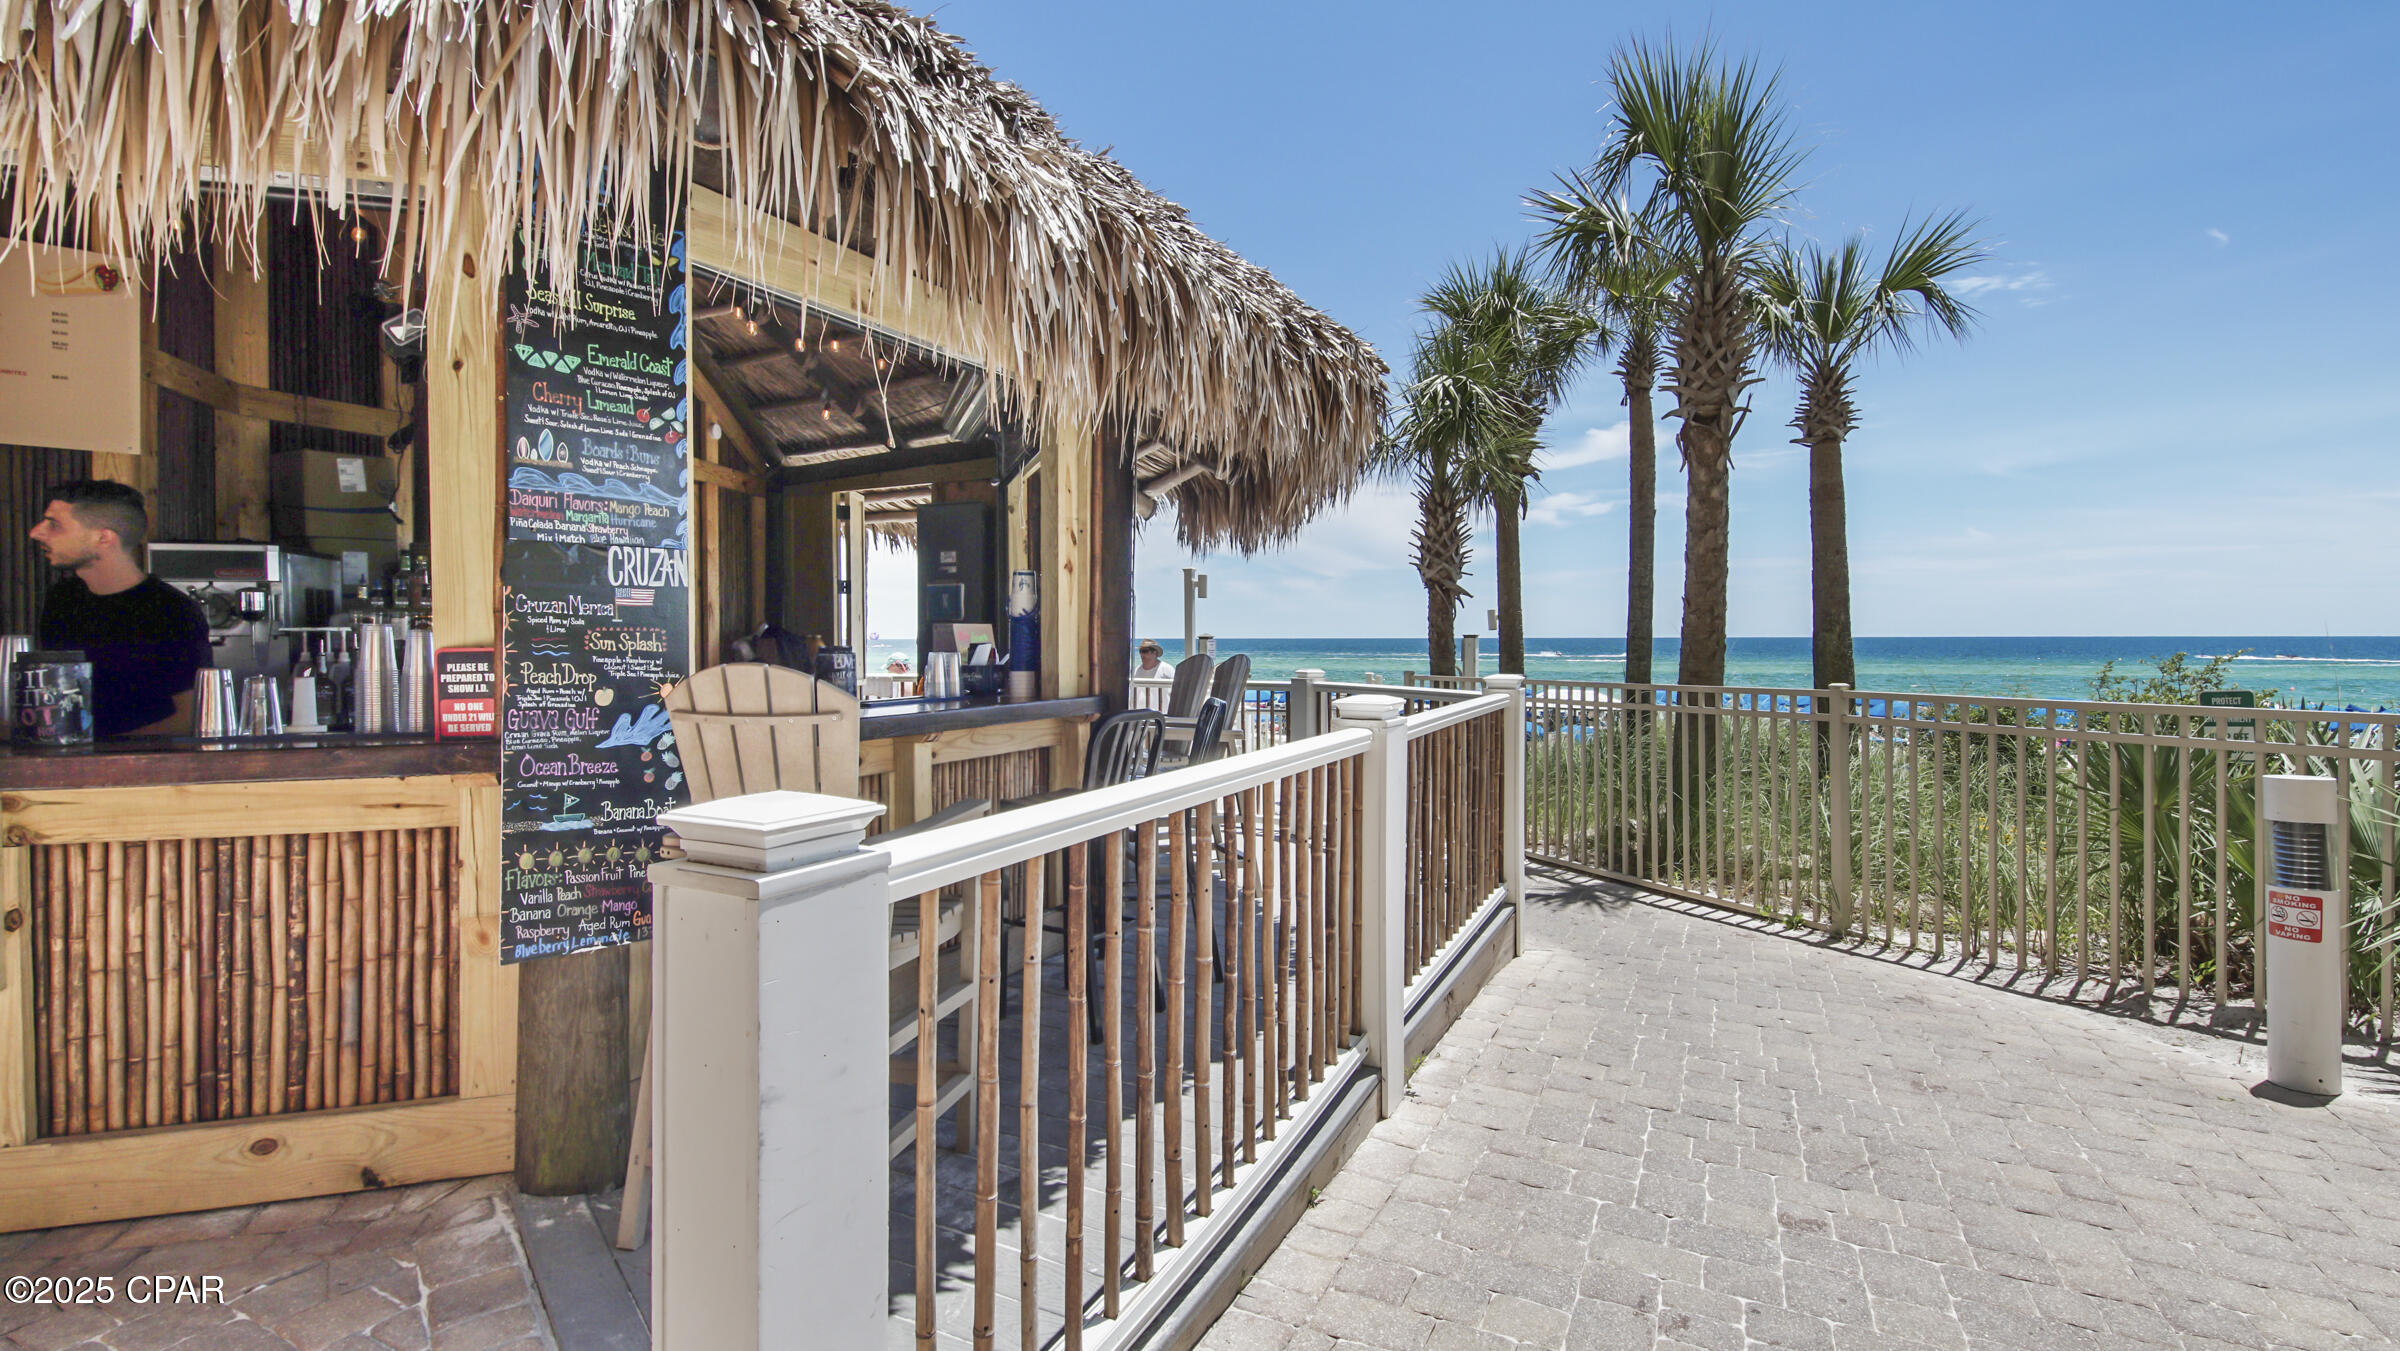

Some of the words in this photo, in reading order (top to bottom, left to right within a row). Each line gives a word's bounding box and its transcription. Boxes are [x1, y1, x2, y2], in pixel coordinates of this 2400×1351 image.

[584, 292, 636, 321] Surprise
[631, 326, 658, 340] Pineapple
[587, 343, 637, 370] Emerald
[640, 353, 673, 377] Coast
[583, 366, 603, 377] Vodka
[532, 381, 583, 416] Cherry
[586, 390, 635, 416] Limeaid
[598, 388, 618, 397] Lemon
[528, 403, 549, 415] Vodka
[581, 437, 624, 460] Boards
[580, 456, 603, 467] Vodka
[612, 460, 630, 471] Peach
[619, 470, 651, 485] Cranberry
[508, 488, 558, 512] Daiquiri
[563, 491, 609, 512] Flavors:
[609, 500, 641, 519] Mango
[643, 502, 670, 518] Peach
[565, 509, 610, 527] Margarita
[610, 512, 657, 528] Hurricane
[509, 516, 528, 528] Piña
[528, 518, 554, 530] Colada
[554, 519, 586, 533] Banana
[586, 522, 629, 538] Strawberry
[536, 533, 553, 542] Mix
[559, 533, 586, 544] Match
[607, 545, 689, 588] CRUZAN
[515, 593, 568, 614] Cruzan
[568, 595, 614, 617] Merica
[527, 615, 547, 626] Spiced
[548, 616, 562, 625] Rum
[550, 625, 566, 633] Lime
[589, 632, 617, 652] Sun
[618, 632, 663, 657] Splash
[446, 662, 476, 673] PLEASE
[477, 662, 489, 672] BE
[592, 655, 622, 666] Pineapple
[603, 663, 626, 671] Coconut
[440, 673, 483, 683] PREPARED
[483, 672, 495, 682] TO
[520, 661, 562, 686] Peach
[561, 662, 597, 692] Drop
[447, 684, 474, 694] SHOW
[475, 683, 489, 693] I.D.
[453, 702, 467, 712] NO
[467, 702, 485, 711] ONE
[2211, 696, 2242, 705] PROTECT
[442, 713, 467, 723] UNDER
[468, 712, 477, 722] 21
[507, 708, 559, 731] Guava
[564, 707, 600, 731] Gulf
[447, 724, 459, 733] BE
[460, 723, 492, 732] SERVED
[519, 753, 568, 777] Ocean
[567, 752, 620, 776] Breeze
[542, 780, 561, 791] Mango
[568, 778, 596, 790] Cranberry
[600, 800, 645, 821] Banana
[644, 796, 677, 820] Boat
[505, 867, 563, 891] Flavors:
[564, 867, 600, 884] Passion
[600, 866, 624, 881] Fruit
[628, 864, 648, 879] Pine
[520, 888, 553, 906] Vanilla
[556, 886, 582, 901] Peach
[582, 883, 641, 900] Strawberry
[2285, 894, 2300, 902] NO
[2272, 897, 2317, 909] SMOKING
[509, 907, 551, 924] Banana
[556, 903, 599, 922] Orange
[601, 899, 638, 917] Mango
[515, 923, 570, 943] Raspberry
[578, 916, 606, 937] Aged
[609, 916, 631, 930] Rum
[632, 910, 652, 927] Gua
[2284, 925, 2300, 933] NO
[2275, 928, 2311, 941] VAPING
[514, 937, 570, 959] Blueberry
